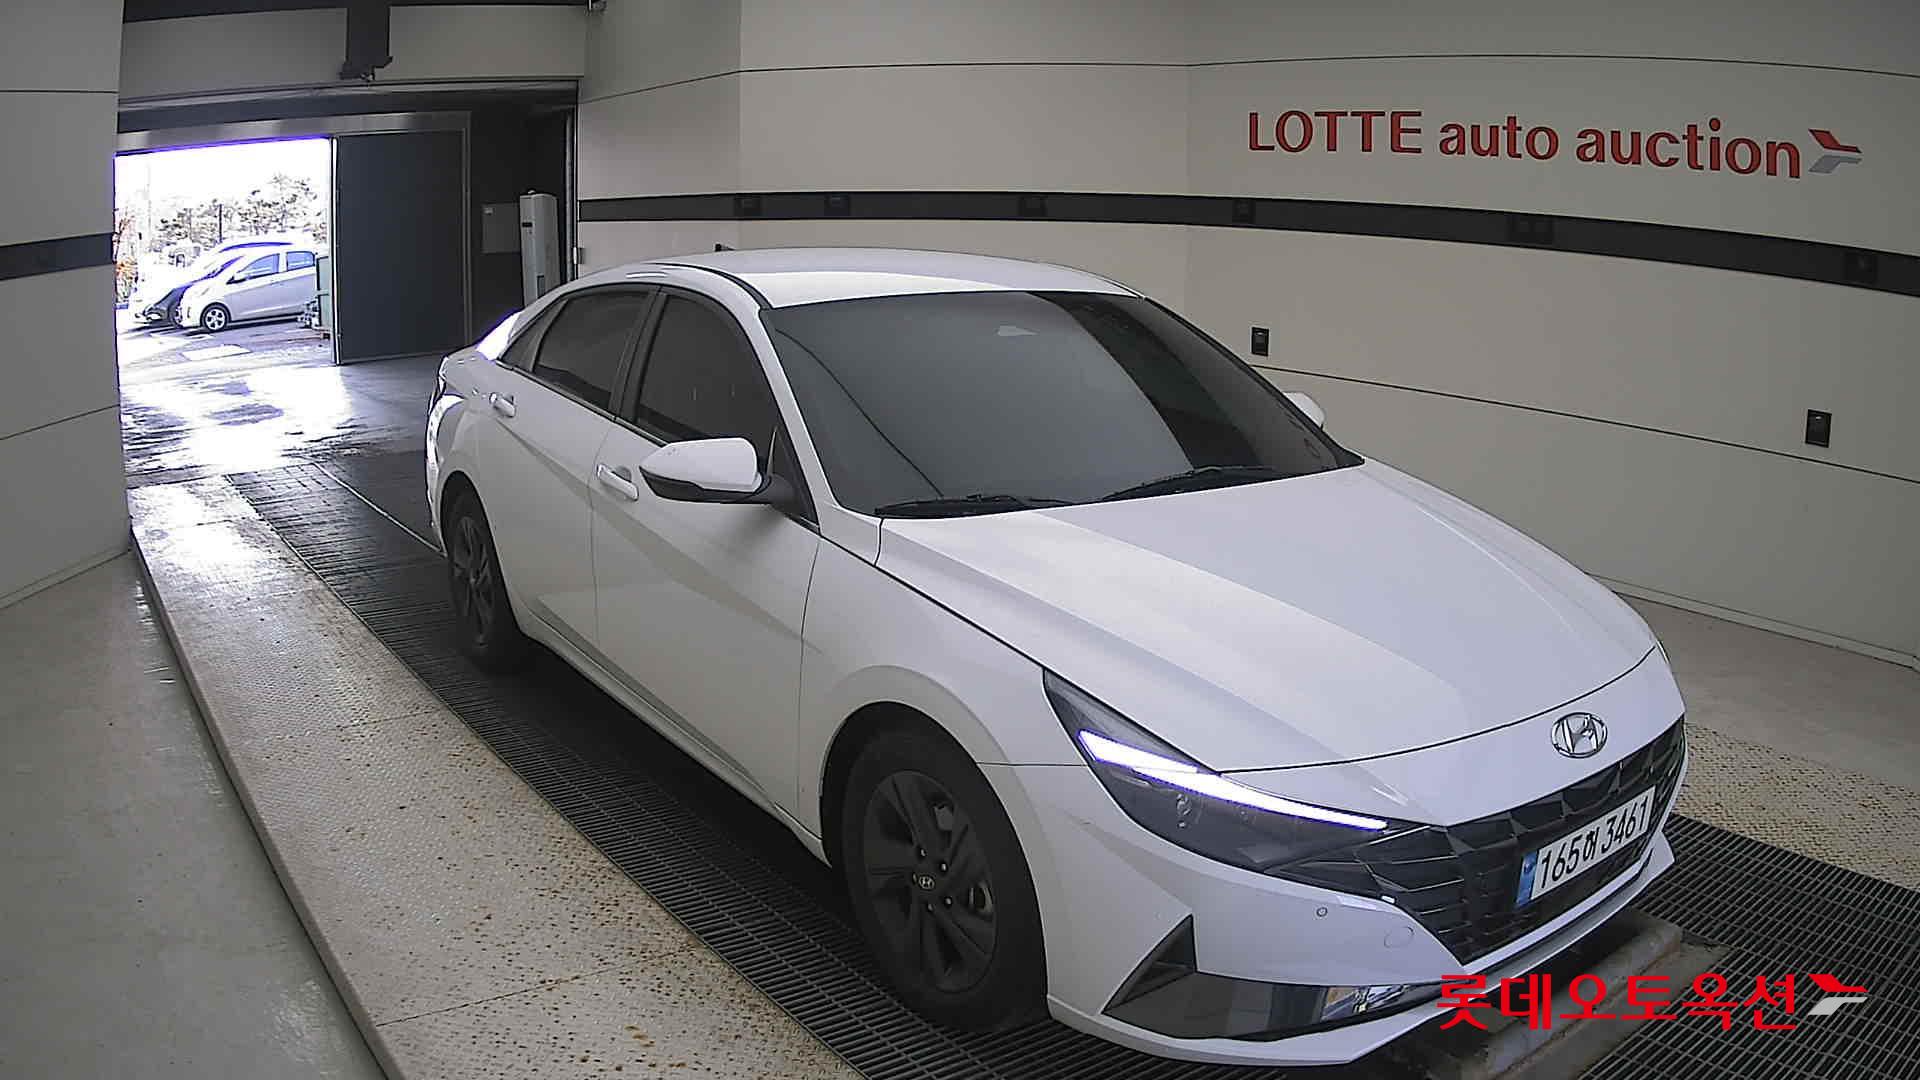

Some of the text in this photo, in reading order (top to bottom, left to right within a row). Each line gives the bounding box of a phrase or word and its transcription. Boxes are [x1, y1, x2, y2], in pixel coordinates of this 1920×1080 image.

[1248, 110, 1802, 178] LOTTE auto auction
